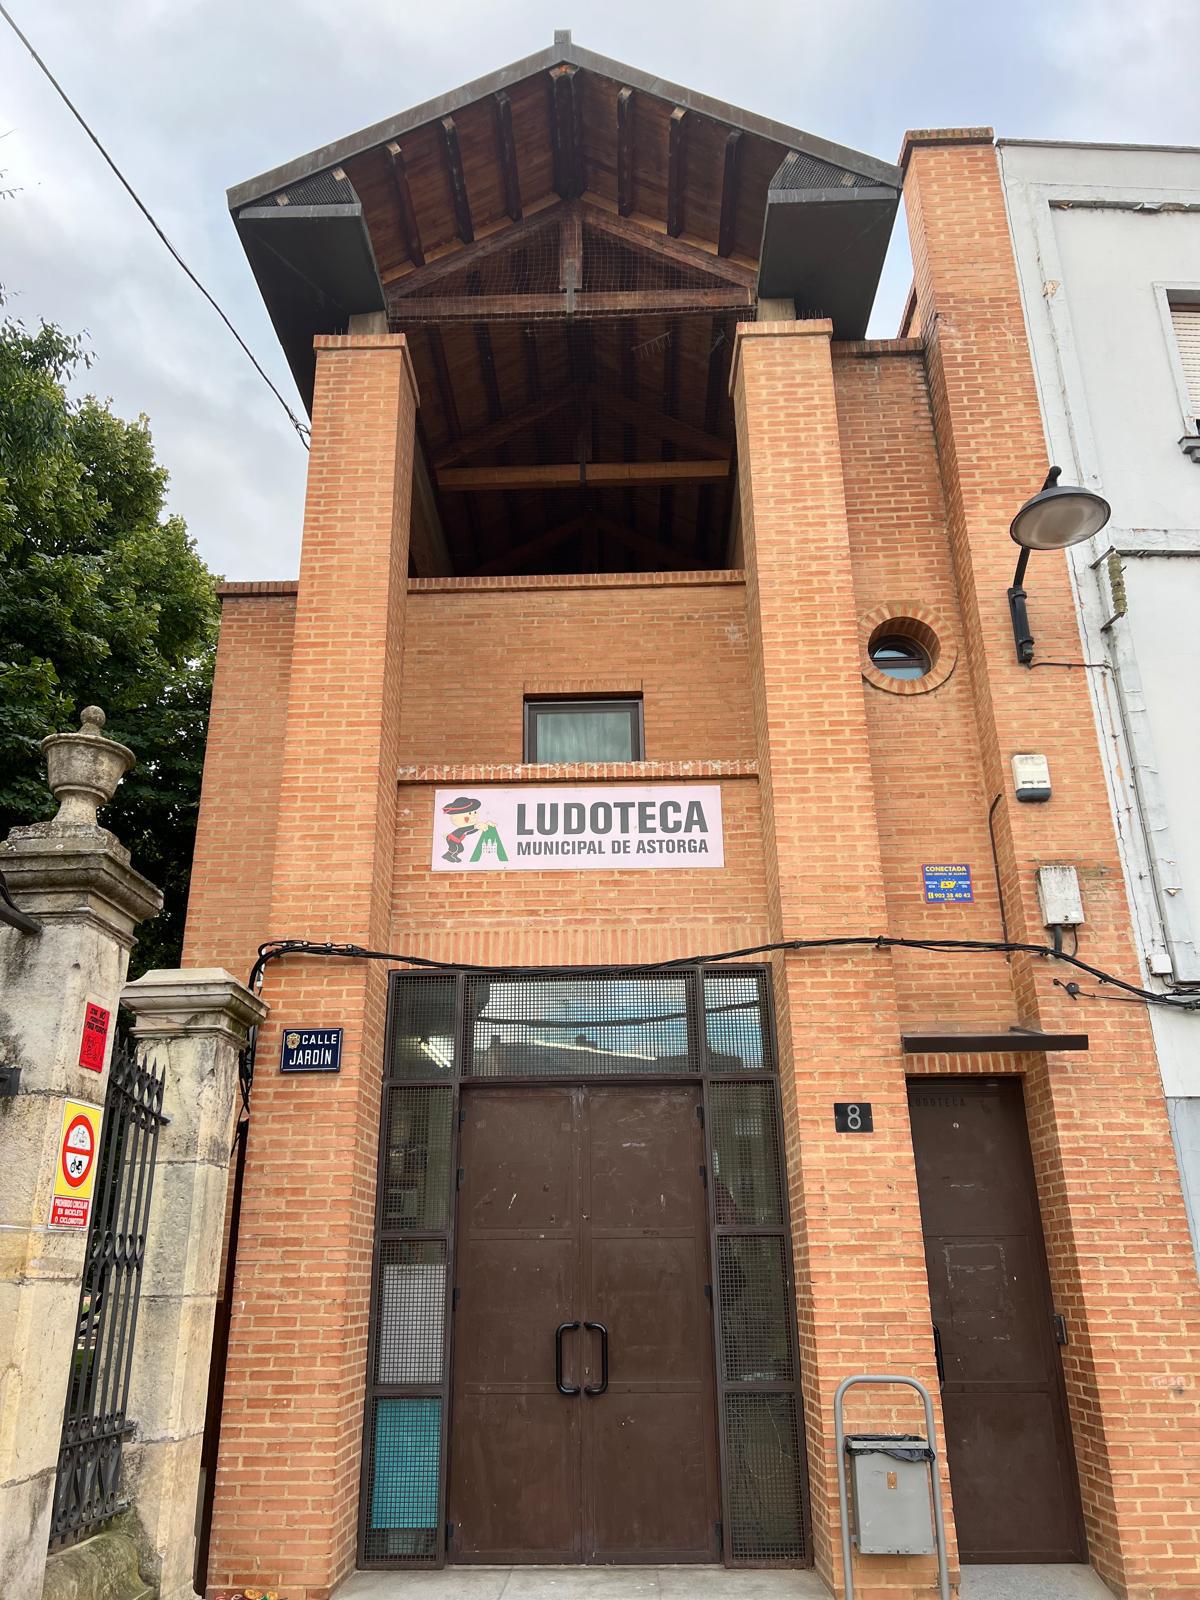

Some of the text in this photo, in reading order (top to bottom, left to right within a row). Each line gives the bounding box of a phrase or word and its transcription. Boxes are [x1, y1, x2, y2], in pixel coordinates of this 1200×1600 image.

[516, 800, 709, 835] LUDOTECA
[517, 839, 708, 855] MUNICIPAL DE ASTORGA
[302, 1034, 337, 1045] CALLE
[289, 1048, 332, 1065] JARDÍN
[847, 1104, 861, 1130] 8
